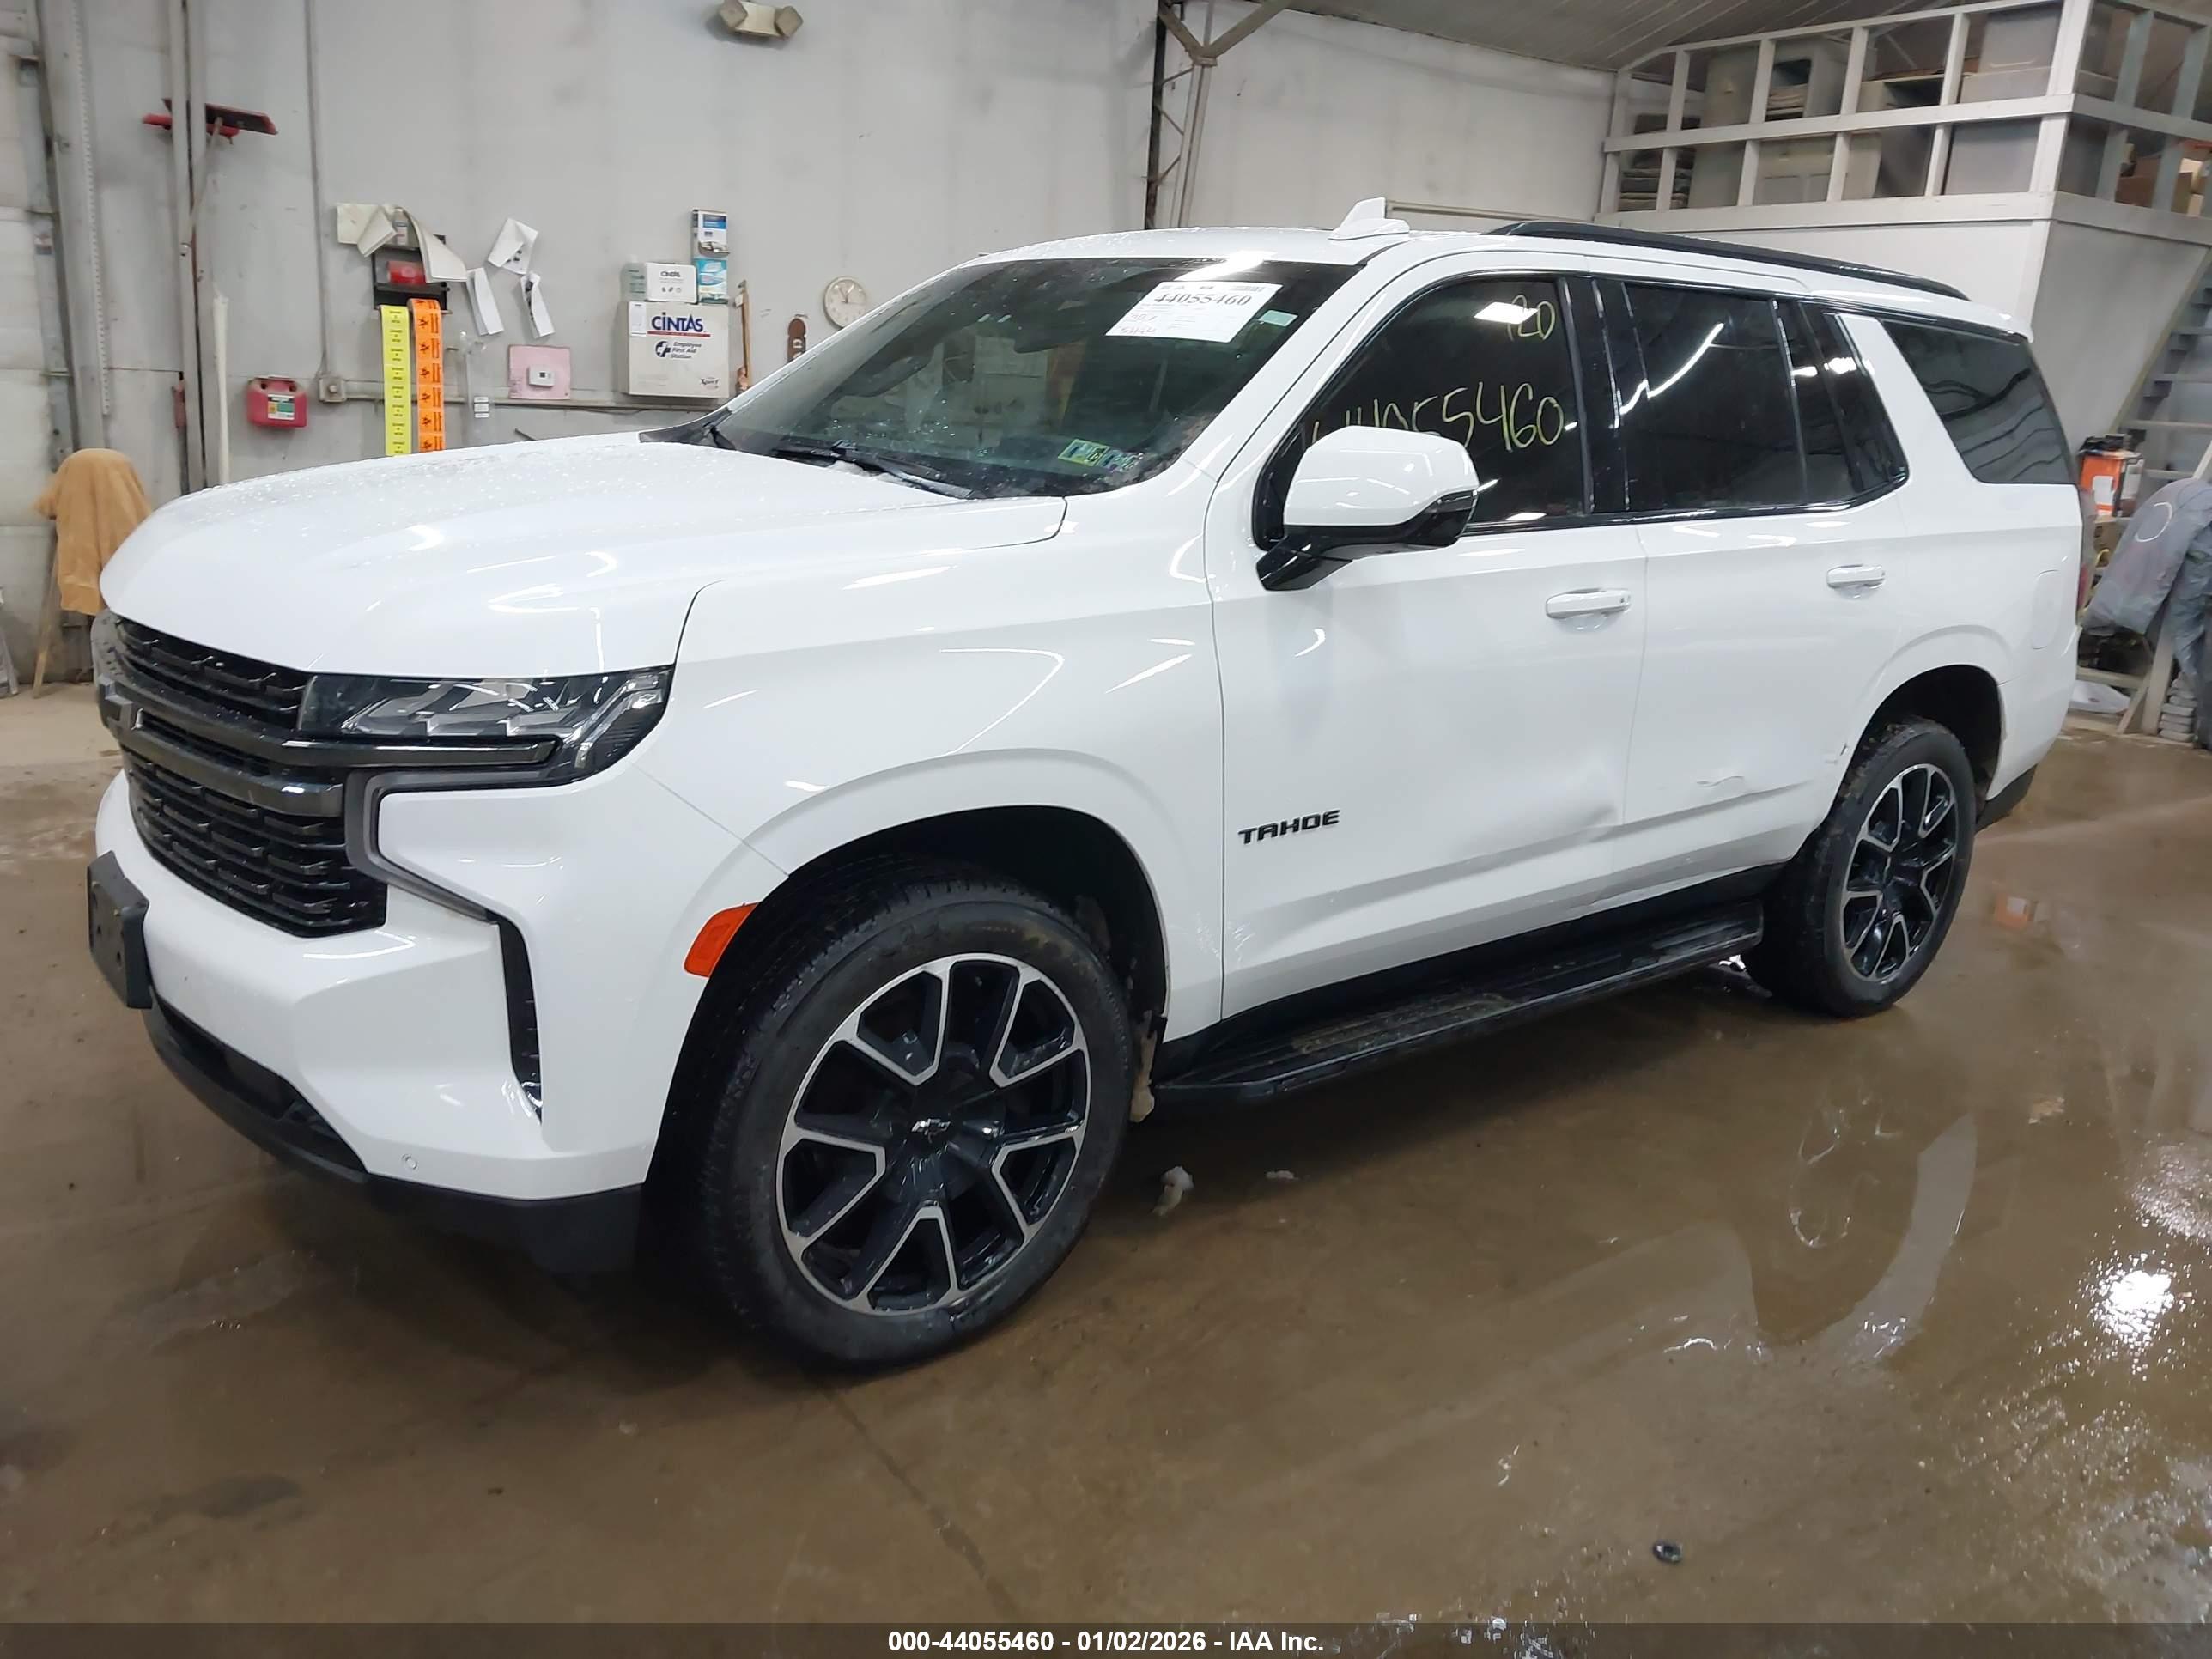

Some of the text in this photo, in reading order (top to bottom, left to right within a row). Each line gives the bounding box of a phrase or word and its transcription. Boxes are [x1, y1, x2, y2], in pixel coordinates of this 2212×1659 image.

[1153, 293, 1252, 306] 44055460
[651, 312, 704, 333] CINTAS
[1237, 809, 1340, 845] TAHOE
